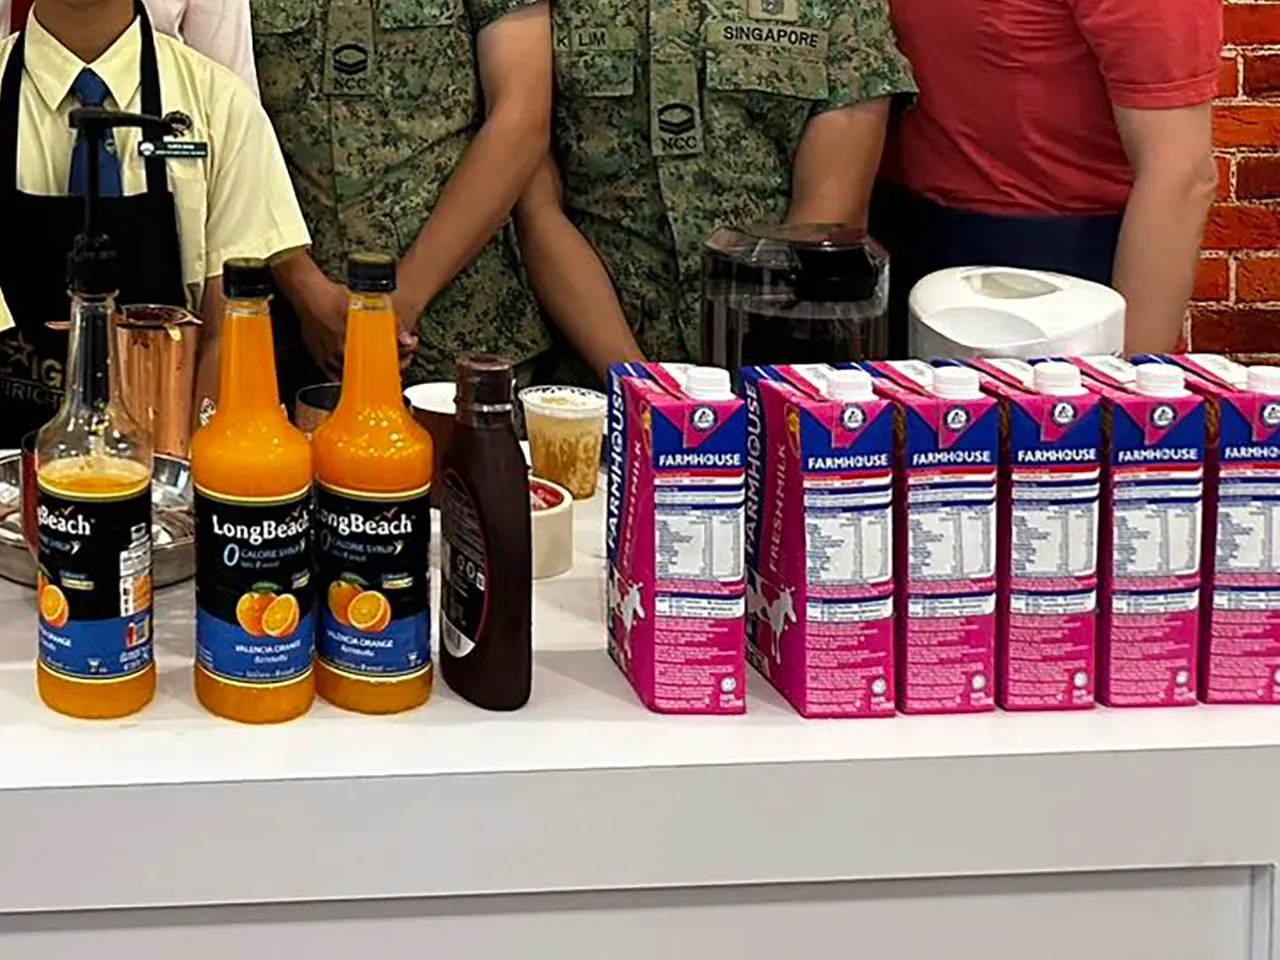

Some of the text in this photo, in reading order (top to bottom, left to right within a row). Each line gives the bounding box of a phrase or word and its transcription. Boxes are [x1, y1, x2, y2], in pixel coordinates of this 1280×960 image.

[723, 25, 819, 48] SINGAPORE
[333, 77, 369, 91] NCC
[661, 136, 698, 151] NCC
[912, 450, 991, 466] FARMHOUSE
[1017, 448, 1097, 462] FARMHOUSE
[1117, 448, 1198, 462] FARMHOUSE
[1224, 445, 1280, 459] FARMHO
[659, 453, 741, 466] FARMHOUSE
[807, 453, 889, 470] FARMHOUSE
[745, 380, 761, 554] FARMHOUSE
[36, 504, 91, 535] Beach
[321, 508, 413, 536] ongBeach
[241, 548, 277, 559] CALORIE
[359, 639, 394, 648] ORANGE
